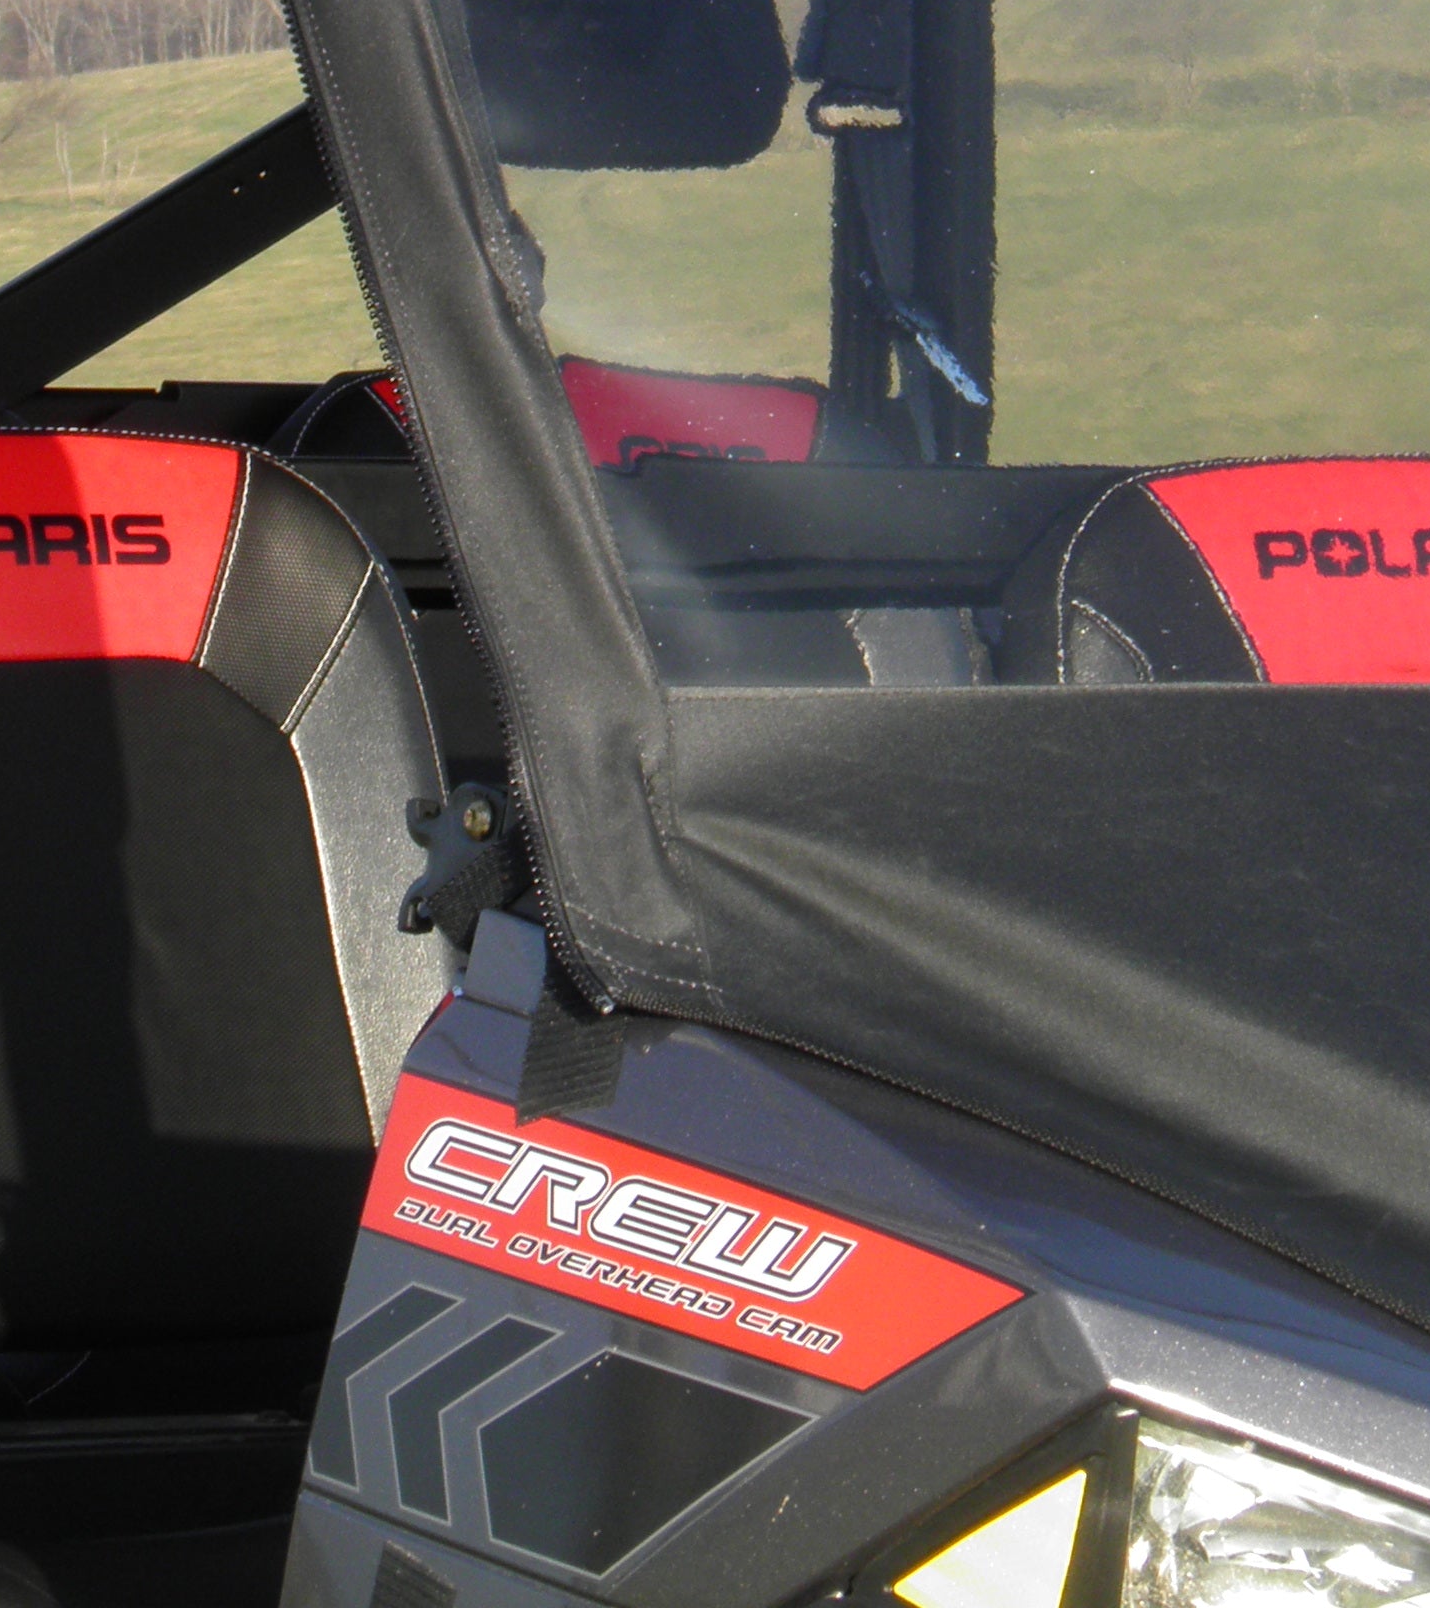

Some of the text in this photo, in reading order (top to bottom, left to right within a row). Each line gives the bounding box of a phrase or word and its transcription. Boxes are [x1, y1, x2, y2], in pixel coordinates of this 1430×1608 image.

[394, 1198, 842, 1354] DUAL OVERHEAD CAM
[404, 1118, 857, 1302] CREW
